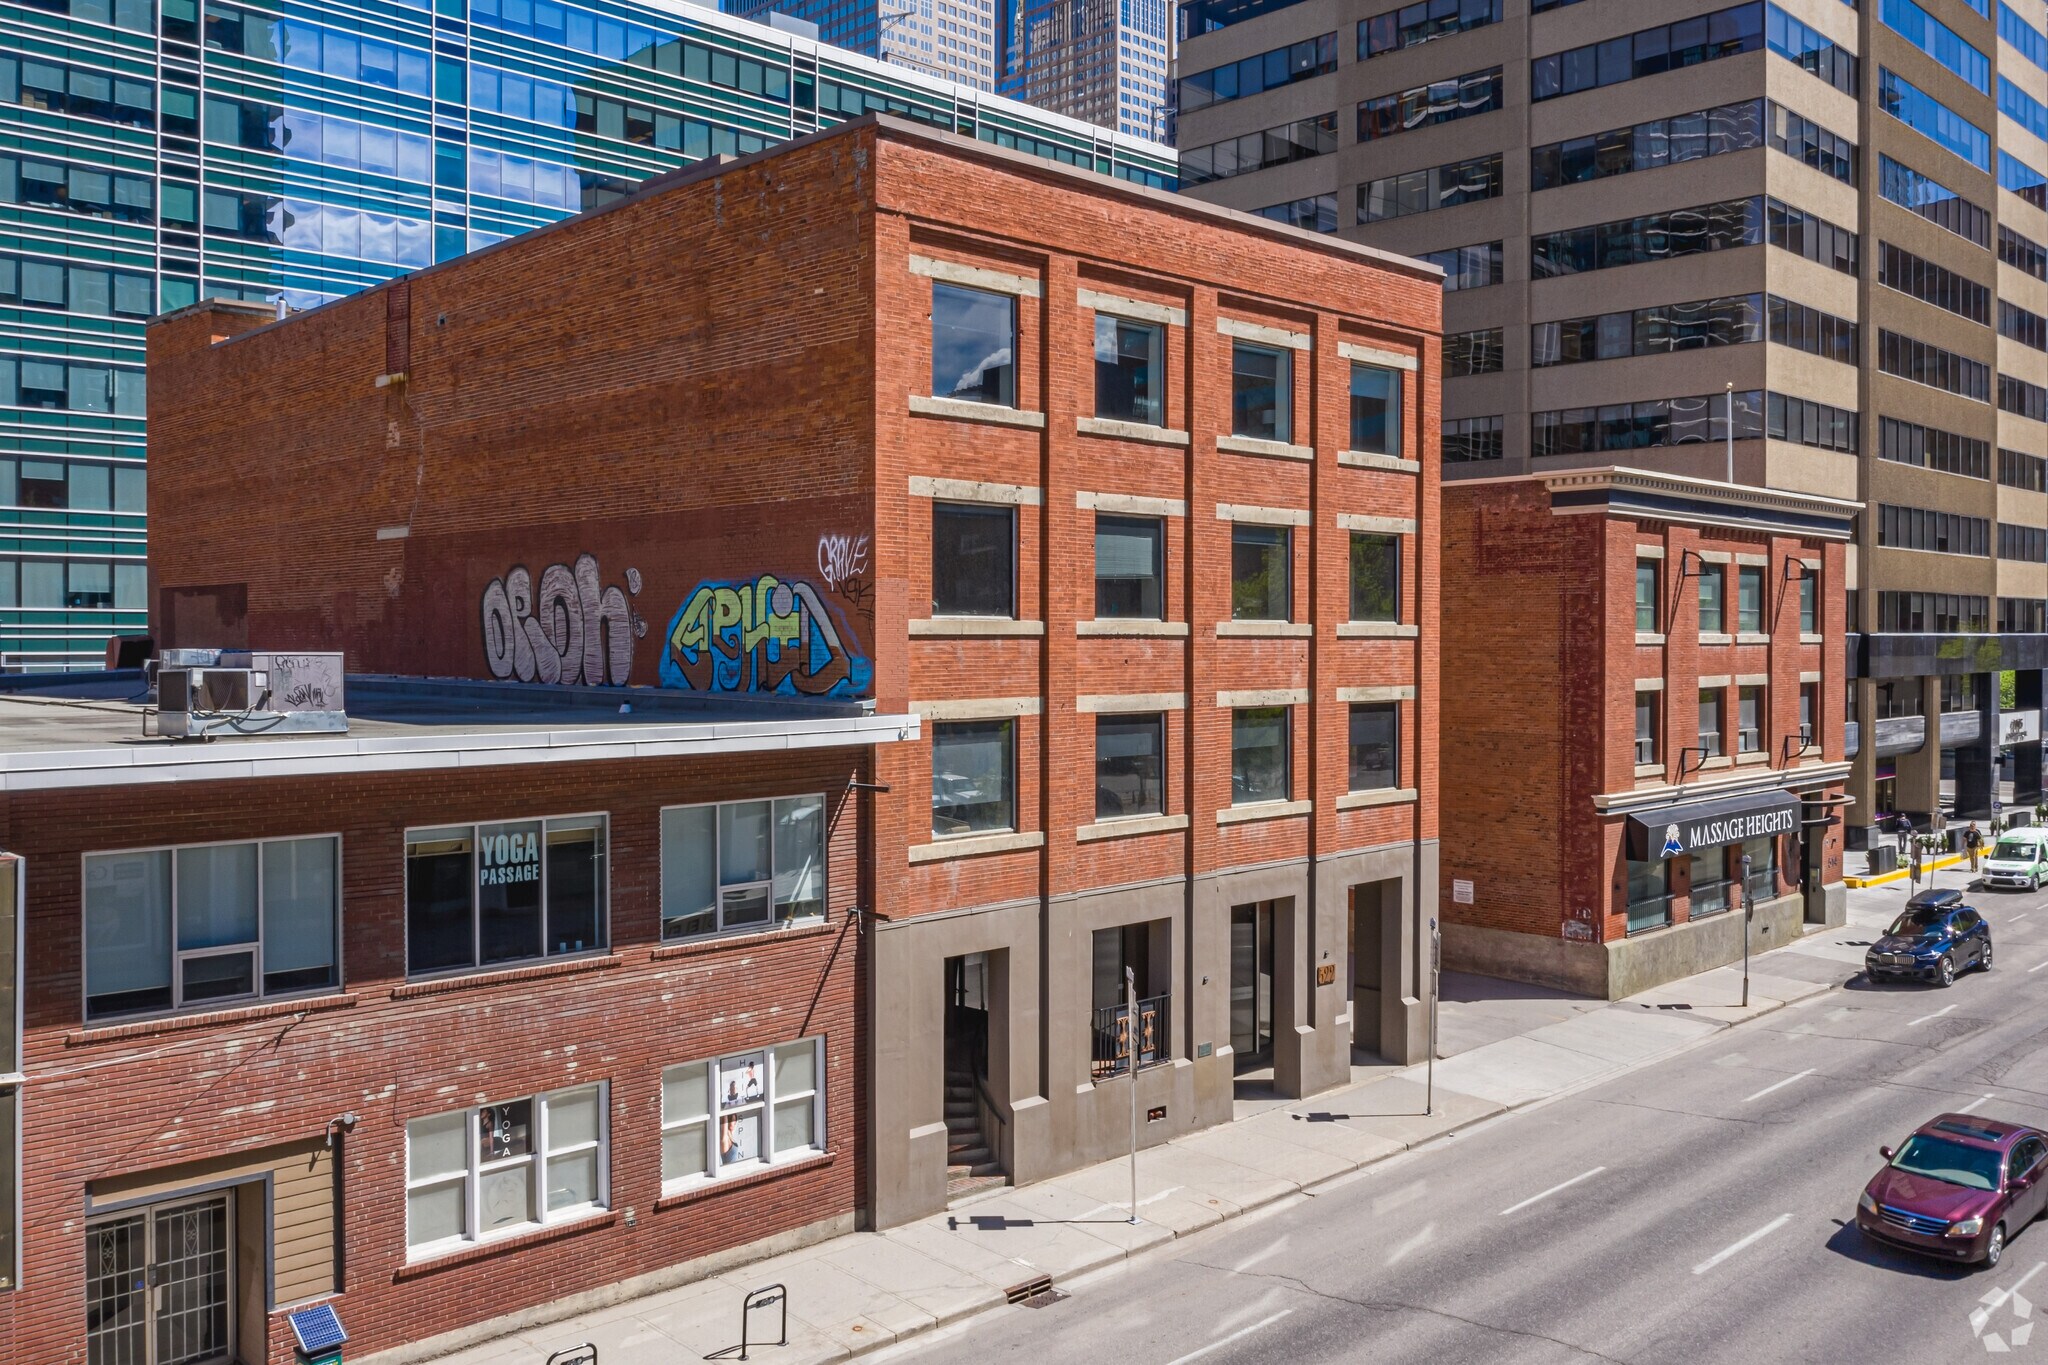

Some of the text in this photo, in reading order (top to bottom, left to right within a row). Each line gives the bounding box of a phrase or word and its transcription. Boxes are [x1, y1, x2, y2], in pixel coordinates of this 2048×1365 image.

[1690, 809, 1793, 848] MASSAGE HEIGHTS
[481, 832, 539, 866] YOGA
[480, 864, 539, 886] PASSAGE
[502, 1106, 511, 1157] YOGA
[737, 1115, 745, 1159] SPIN
